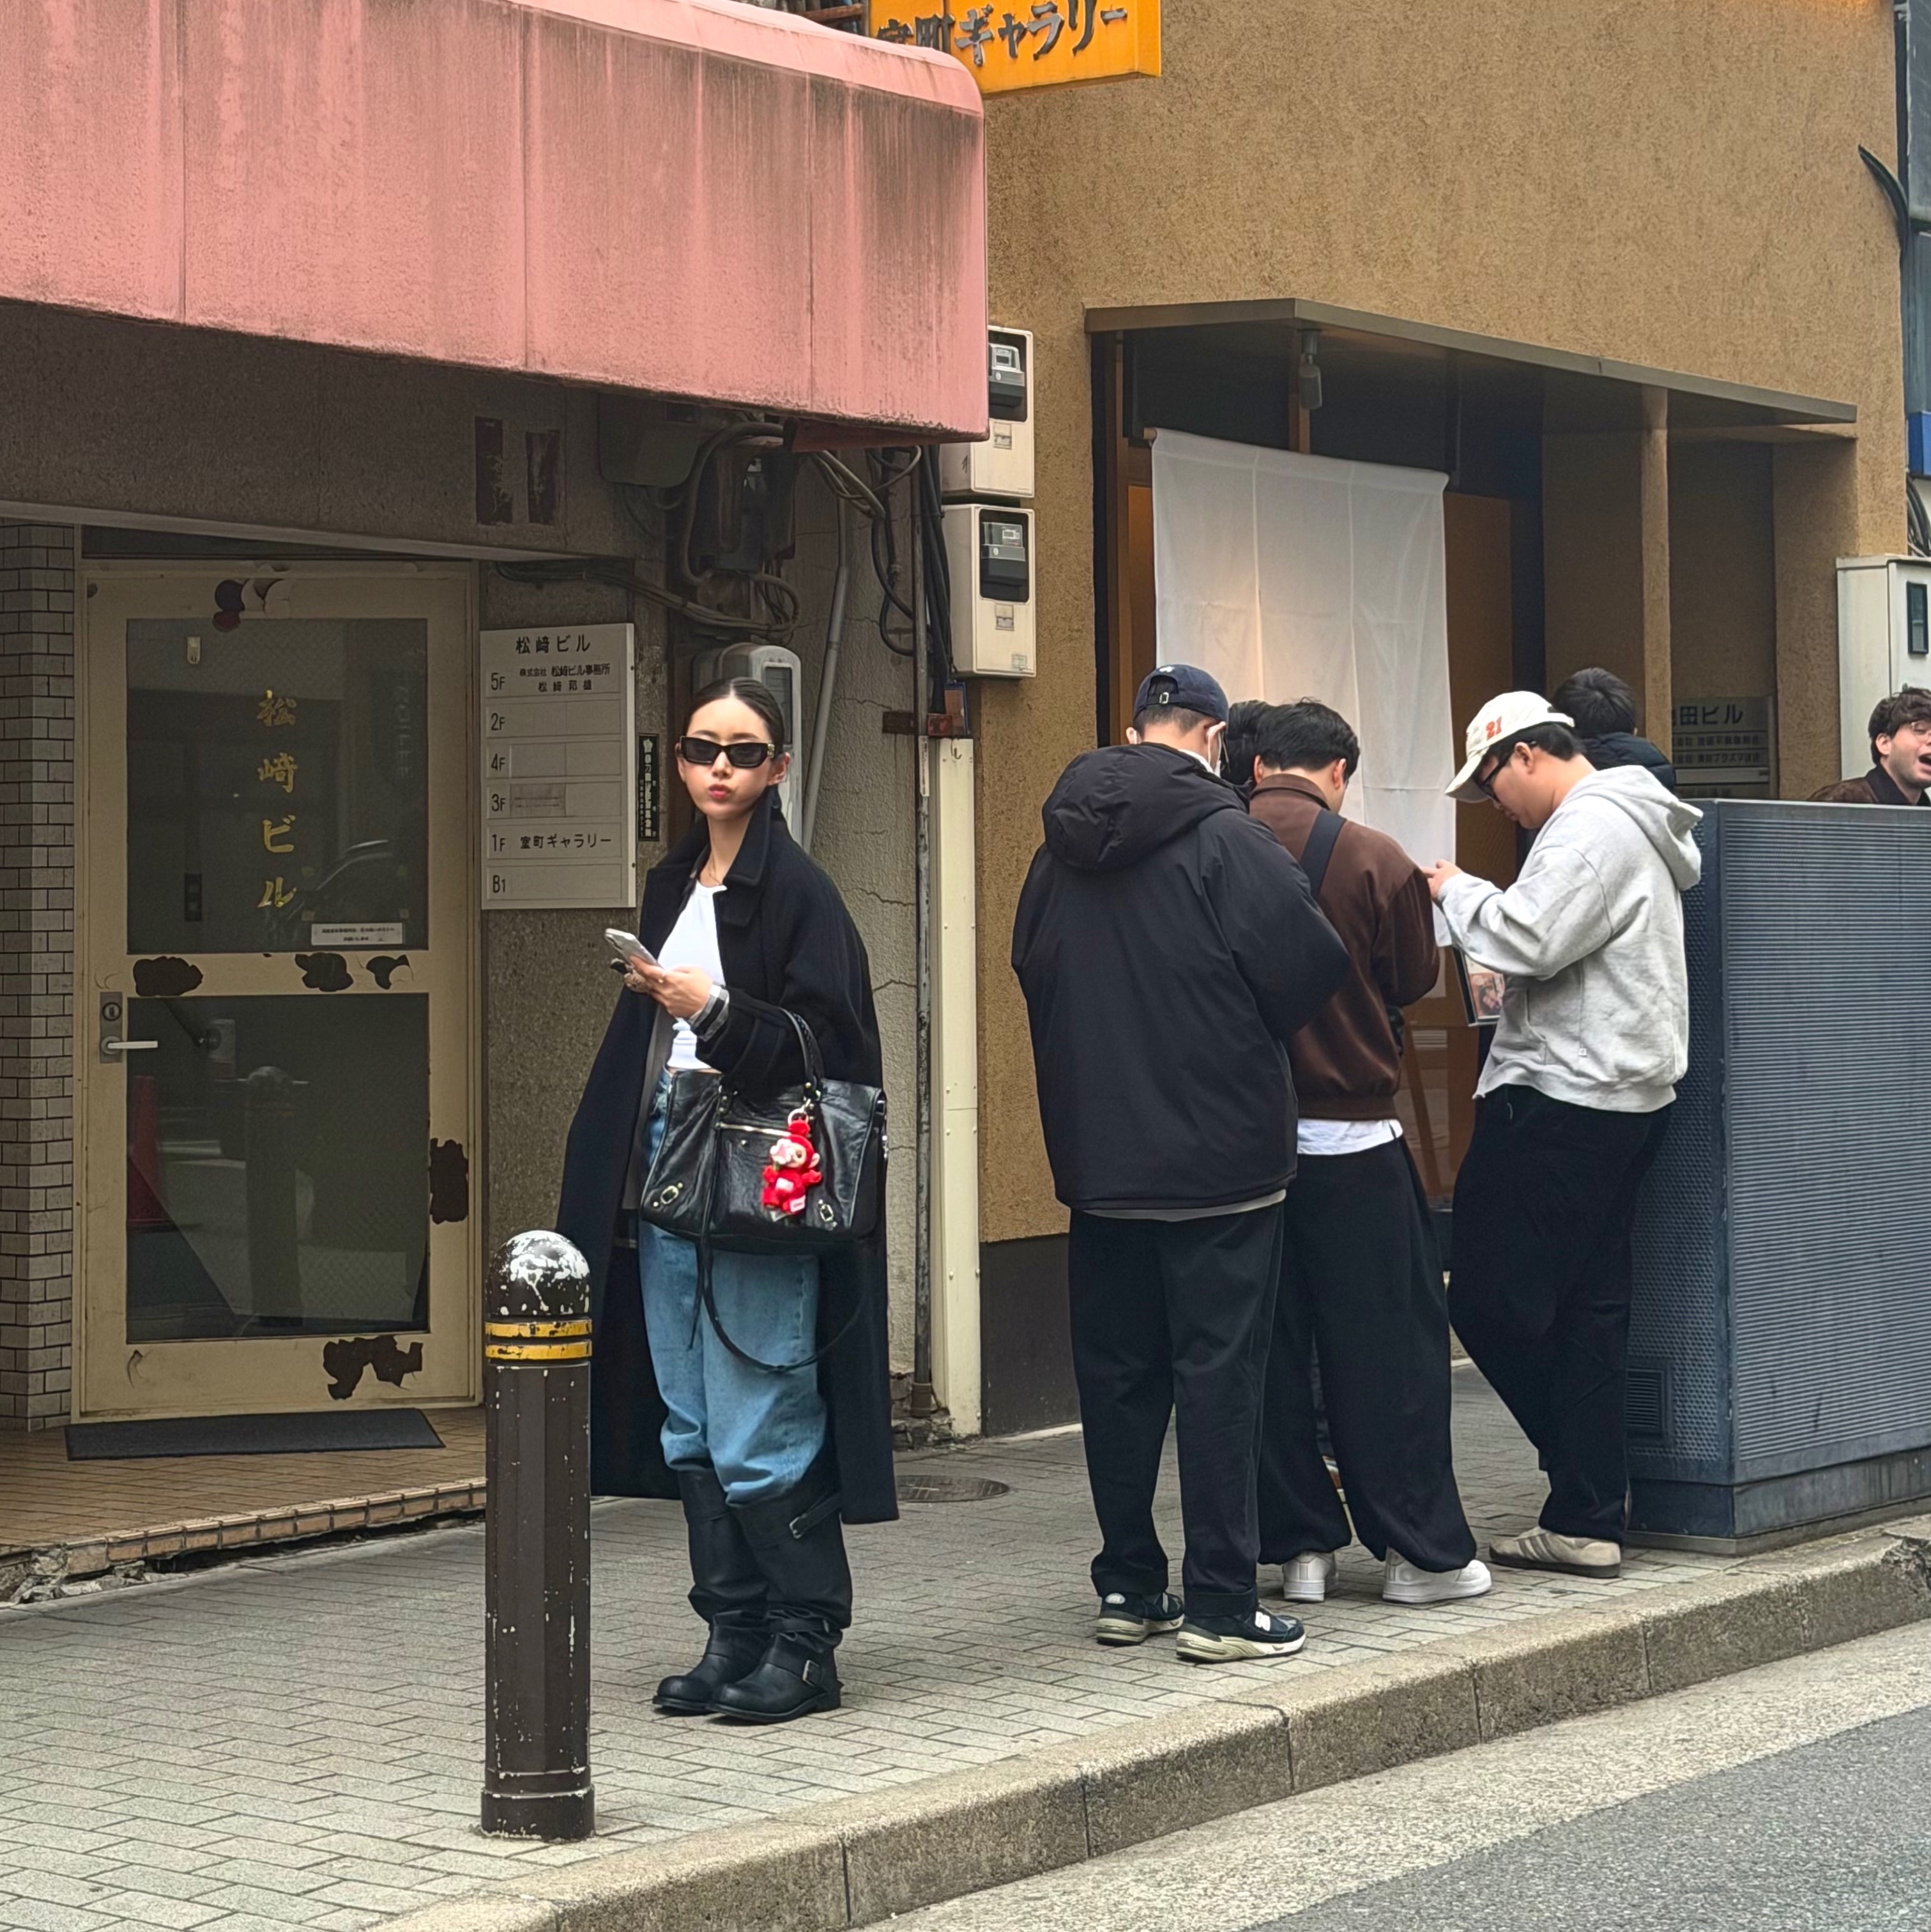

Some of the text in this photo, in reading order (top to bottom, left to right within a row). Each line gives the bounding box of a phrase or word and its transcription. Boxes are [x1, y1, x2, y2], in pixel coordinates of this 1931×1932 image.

[491, 672, 506, 691] 5F
[491, 713, 505, 731] 2F
[1673, 704, 1744, 726] 田ビル
[491, 753, 505, 772] 4F
[491, 794, 505, 812] 3F
[492, 834, 506, 852] 1F
[520, 833, 612, 849] 室町ギャラリー
[492, 875, 506, 893] B1
